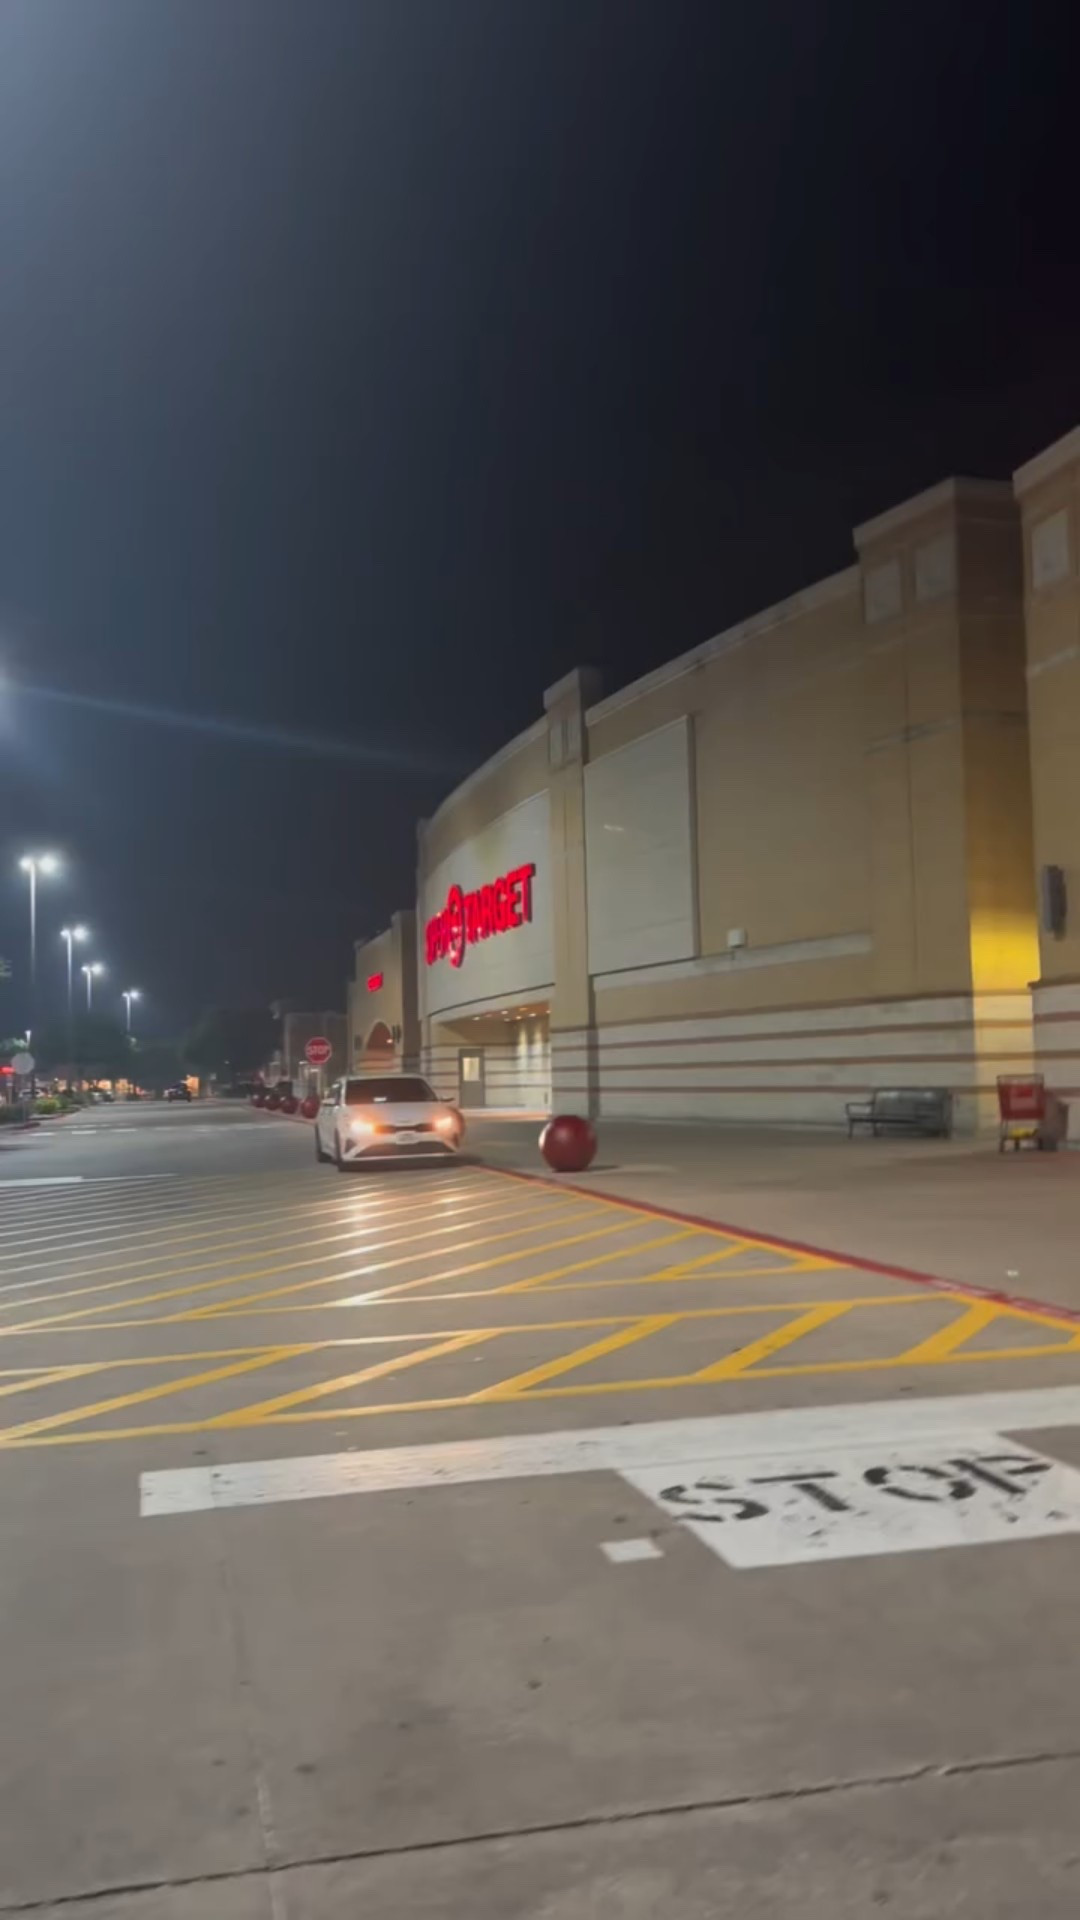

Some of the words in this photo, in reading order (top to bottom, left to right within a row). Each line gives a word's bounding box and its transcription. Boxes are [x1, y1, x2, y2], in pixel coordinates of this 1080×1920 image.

[463, 863, 535, 944] TARGET
[306, 1044, 330, 1056] STOP
[659, 1454, 1053, 1523] STOP
